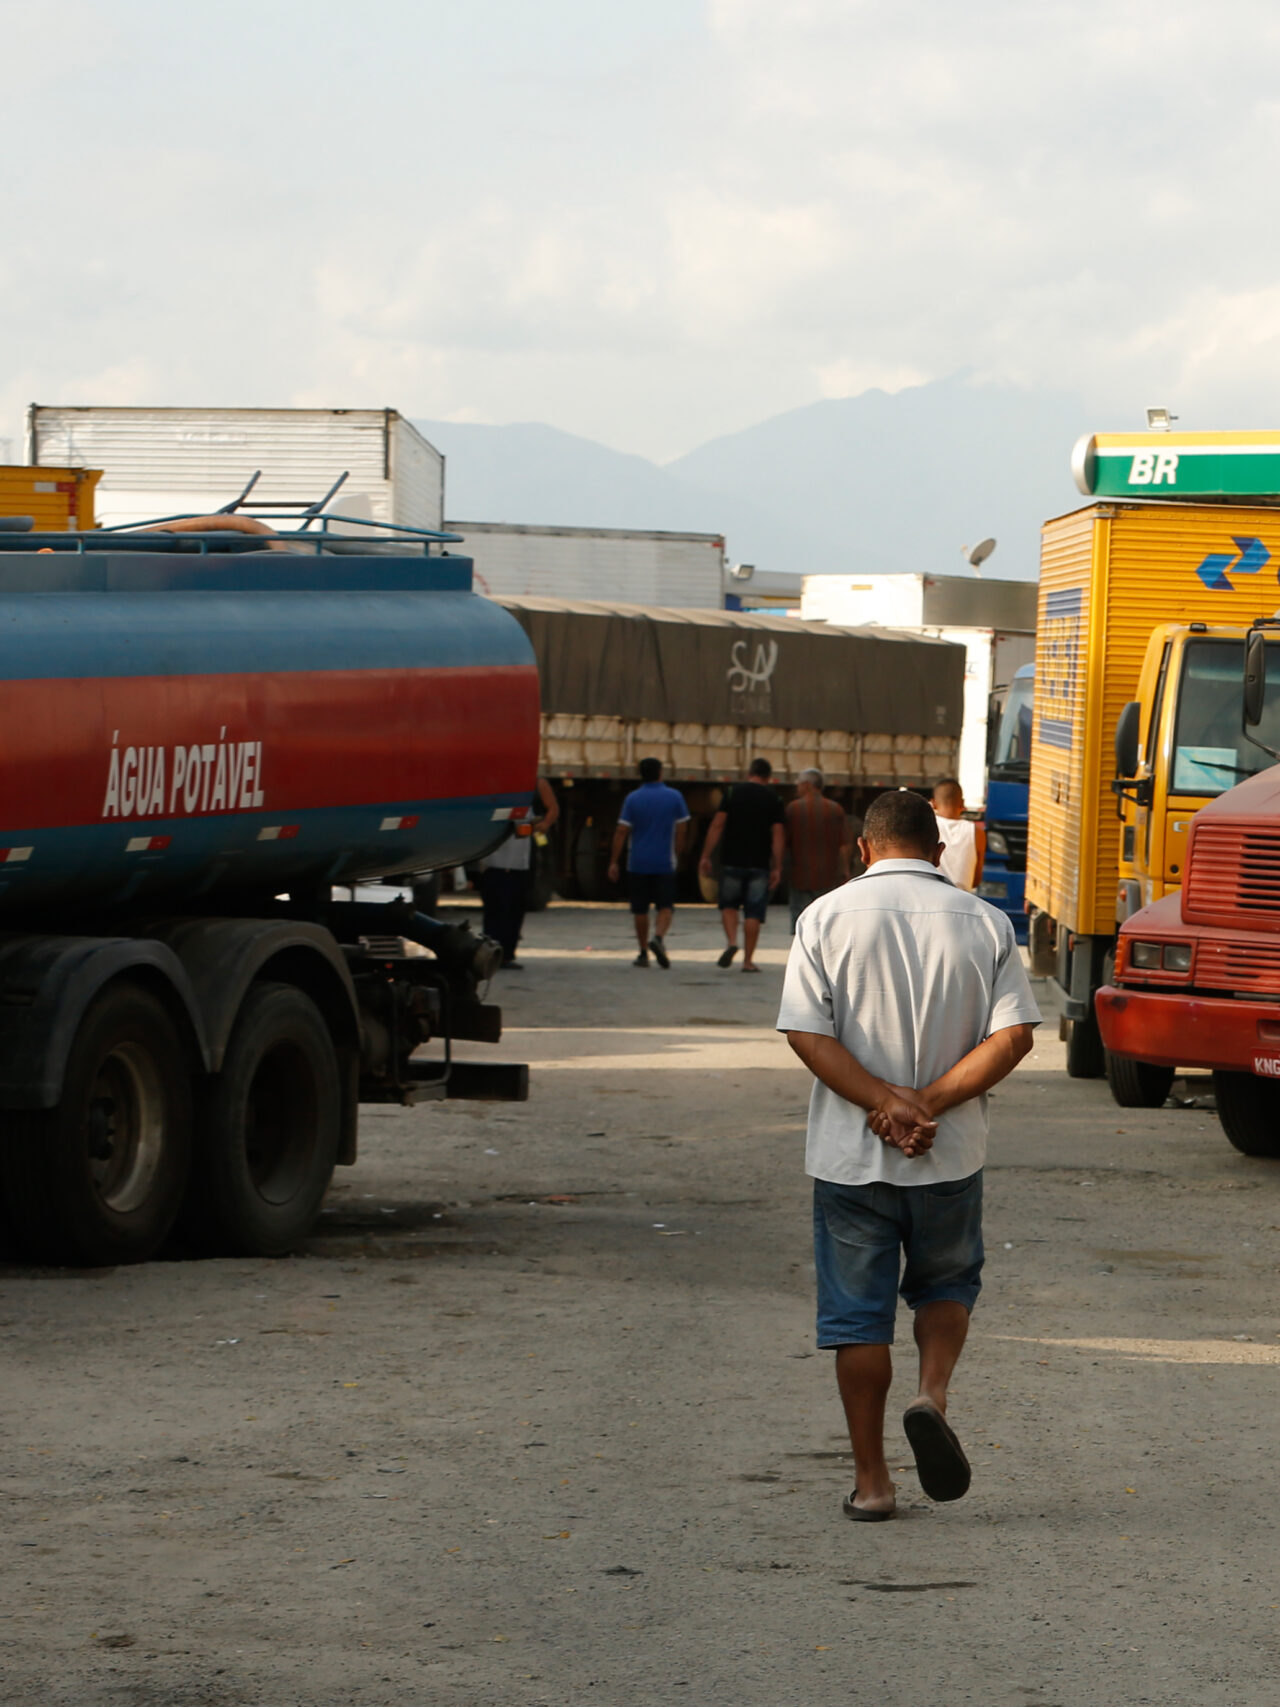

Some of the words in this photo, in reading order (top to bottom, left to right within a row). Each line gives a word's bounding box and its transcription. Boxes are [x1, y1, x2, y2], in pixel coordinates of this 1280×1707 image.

[1128, 453, 1179, 485] BR
[102, 730, 164, 817] ÁGUA
[169, 726, 264, 813] POTÁVEL
